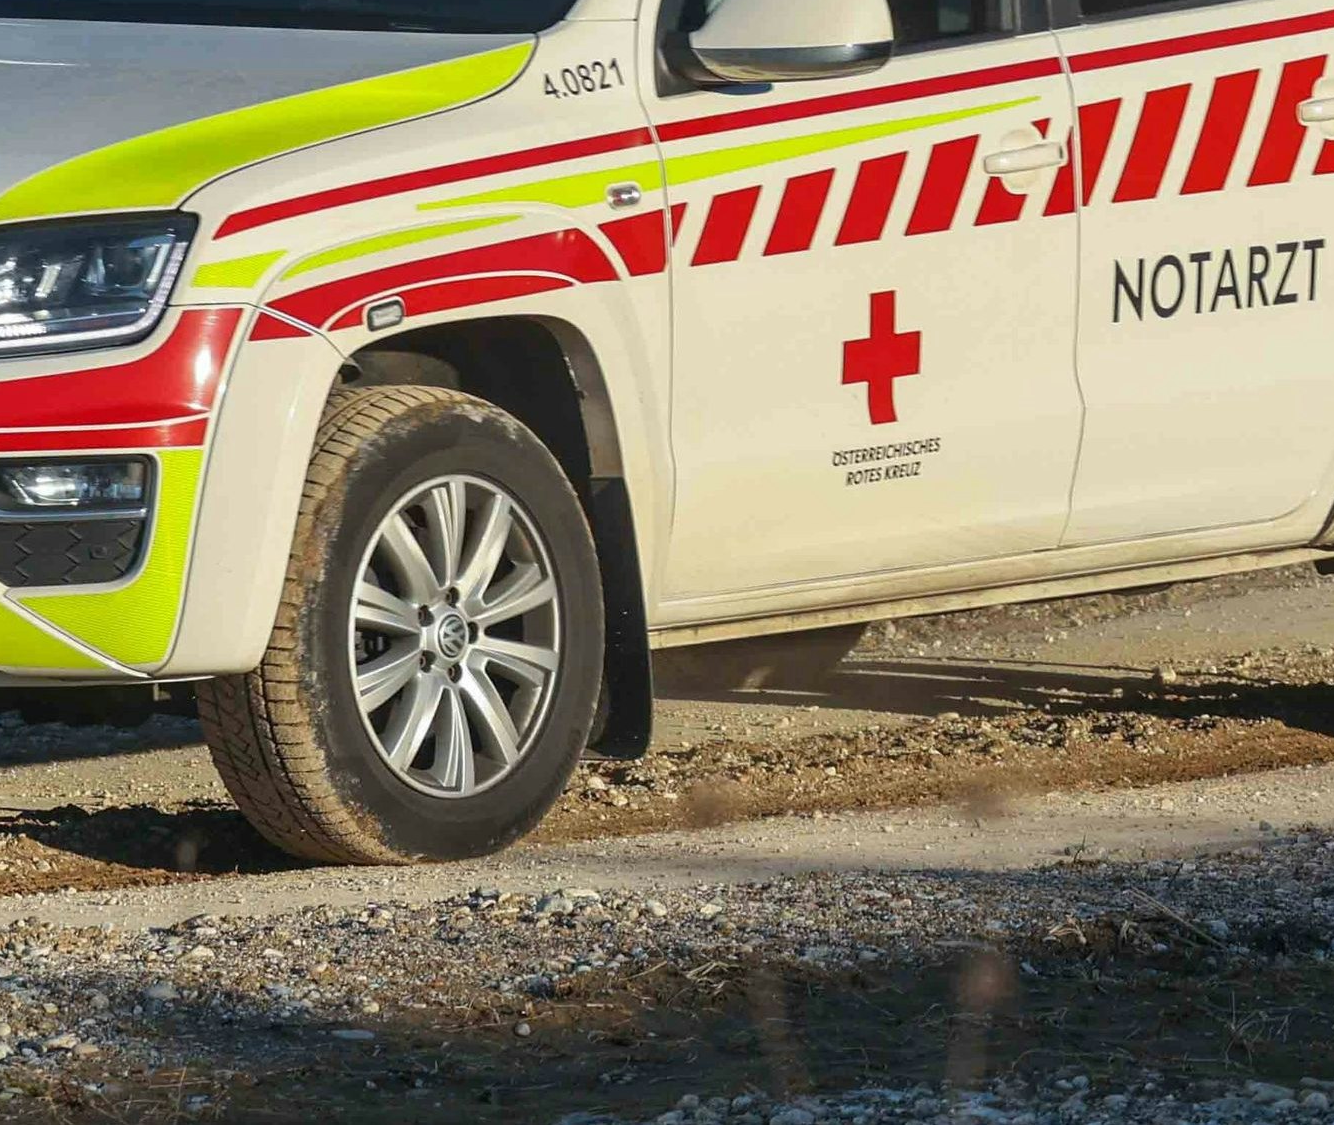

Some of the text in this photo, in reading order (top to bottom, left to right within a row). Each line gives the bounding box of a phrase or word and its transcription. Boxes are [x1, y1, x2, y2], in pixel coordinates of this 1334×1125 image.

[544, 58, 624, 98] 4.0821
[1111, 238, 1326, 323] NOTARZT
[832, 436, 942, 467] ÖSTERREICHISCHES
[845, 461, 922, 486] ROTES KREUZ
